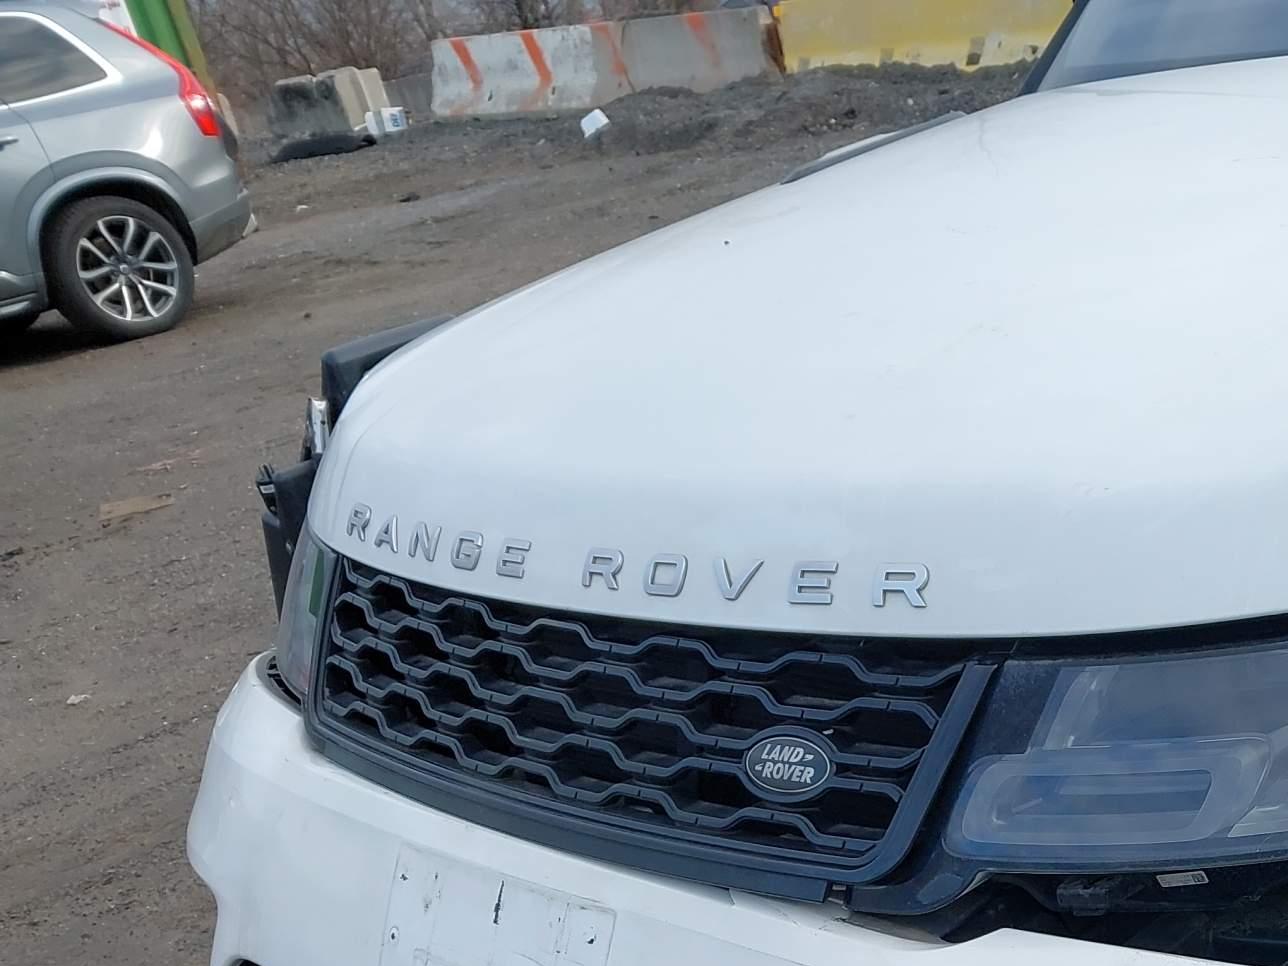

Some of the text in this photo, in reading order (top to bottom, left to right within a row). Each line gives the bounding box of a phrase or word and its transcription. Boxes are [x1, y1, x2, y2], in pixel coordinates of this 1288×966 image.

[345, 501, 930, 609] RANGE ROVER
[760, 743, 805, 763] LAND
[761, 761, 815, 784] ROVER
